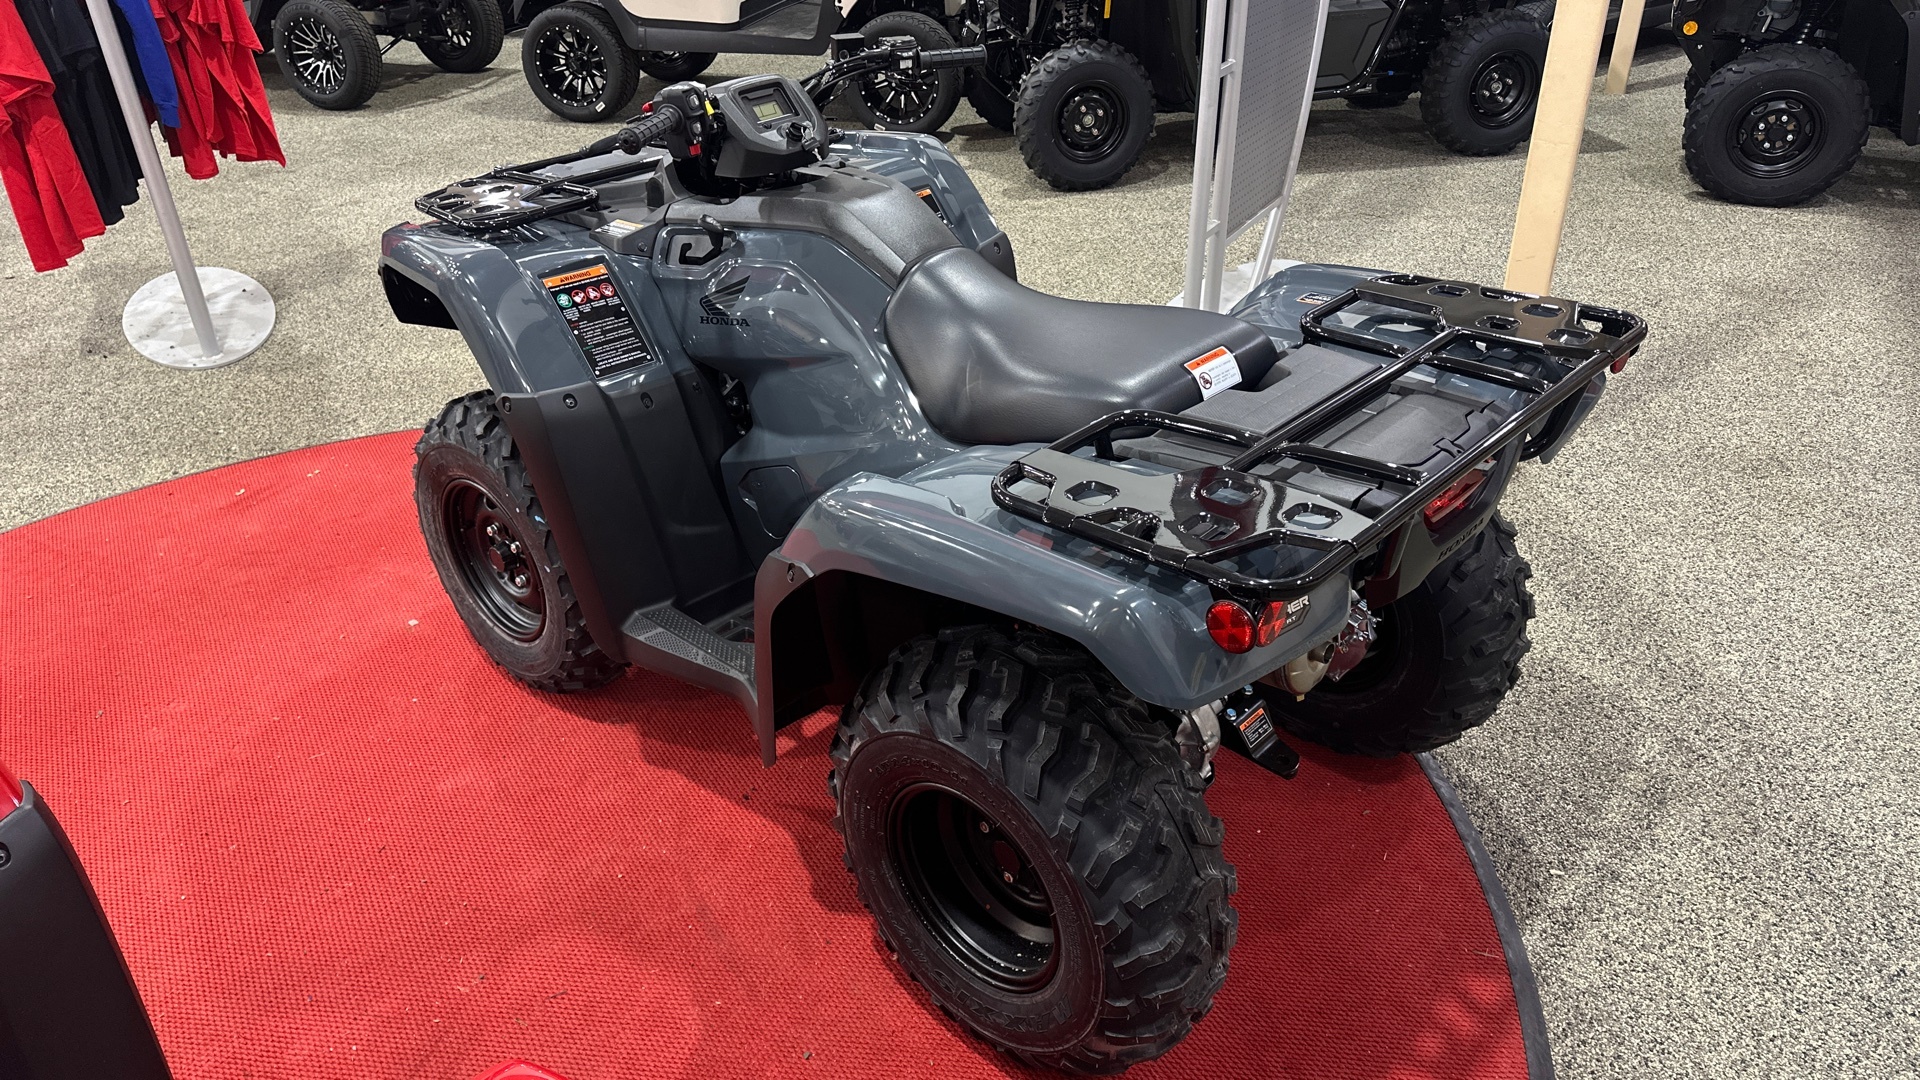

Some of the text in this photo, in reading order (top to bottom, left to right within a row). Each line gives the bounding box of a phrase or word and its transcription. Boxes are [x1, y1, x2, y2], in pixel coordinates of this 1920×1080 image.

[562, 270, 592, 283] WARNING
[700, 316, 750, 326] HONDA
[1437, 517, 1484, 562] HONDA
[930, 968, 1073, 1034] MAXXIS
